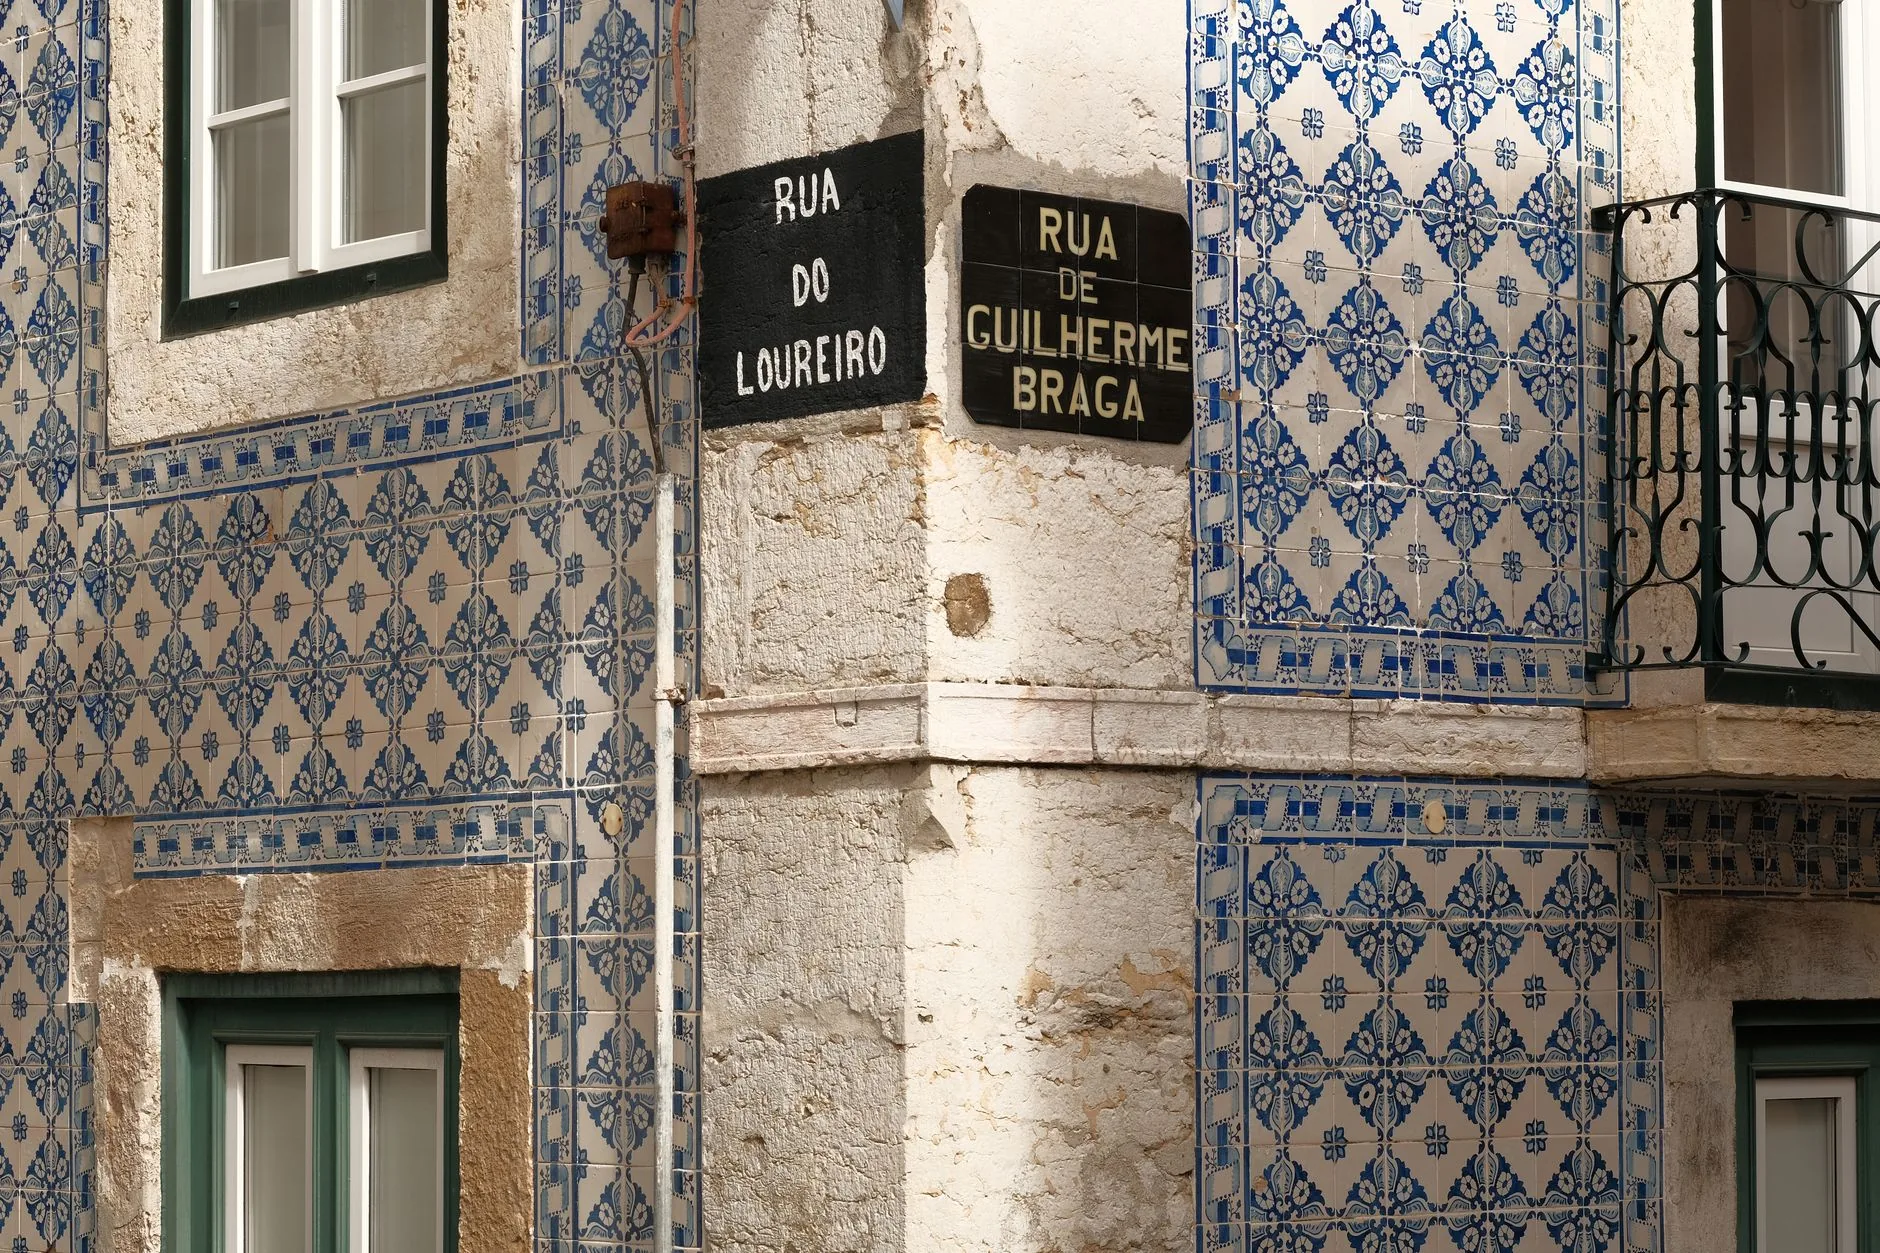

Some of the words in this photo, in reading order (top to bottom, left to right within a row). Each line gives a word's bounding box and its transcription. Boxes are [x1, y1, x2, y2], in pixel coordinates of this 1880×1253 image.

[774, 168, 840, 225] RUA
[1039, 207, 1117, 261] RUA
[792, 257, 830, 307] DO
[1059, 267, 1098, 304] DE
[736, 325, 886, 396] LOUREIRO
[967, 304, 1189, 372] GUILHERME
[1013, 366, 1145, 421] BRAGA
